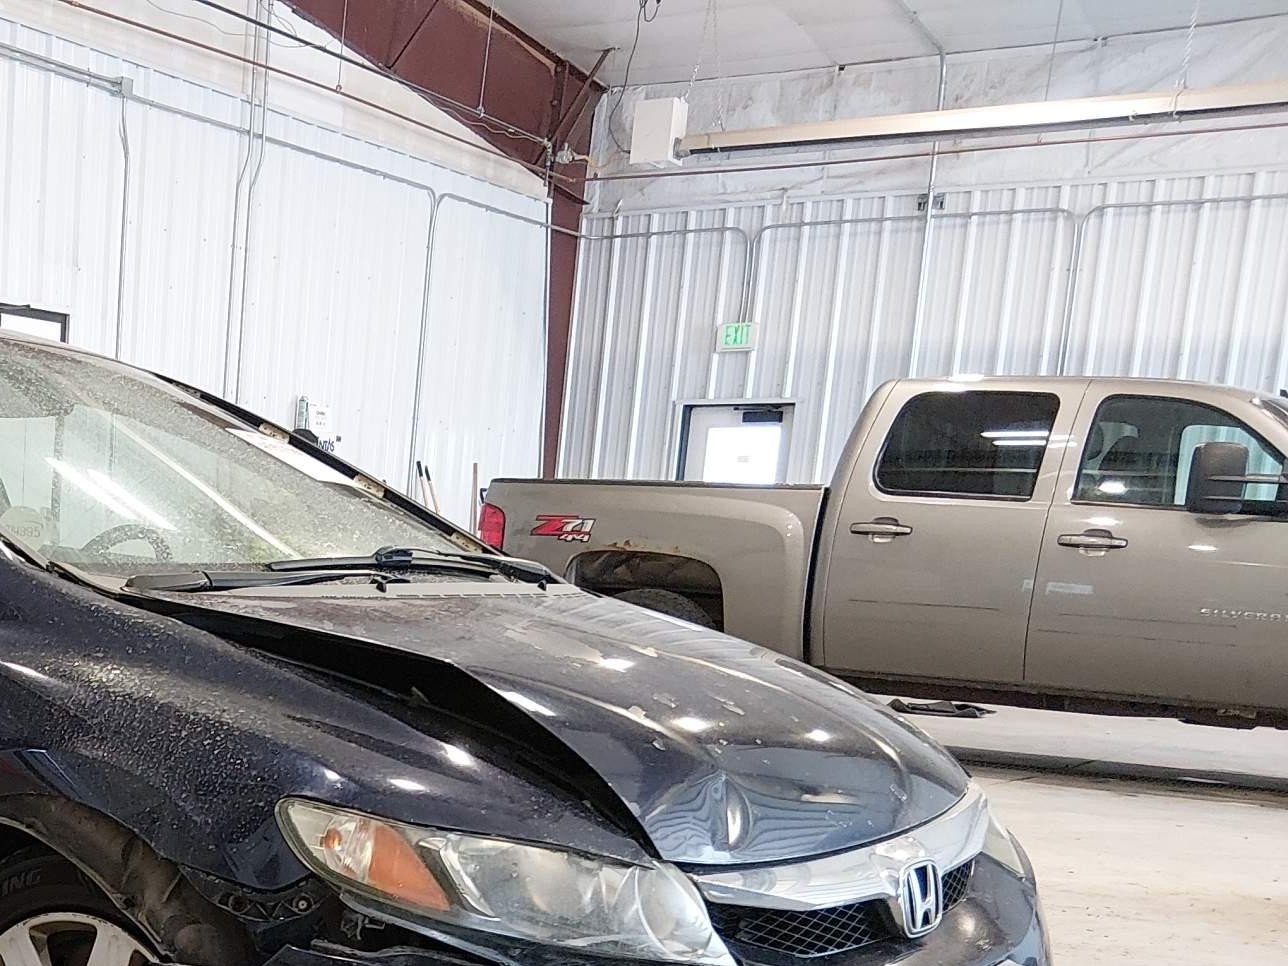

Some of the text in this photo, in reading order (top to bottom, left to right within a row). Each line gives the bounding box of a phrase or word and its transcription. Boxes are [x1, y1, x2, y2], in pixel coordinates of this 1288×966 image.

[725, 324, 751, 345] EXIT
[530, 515, 596, 536] Z71
[1200, 608, 1288, 622] SILVERA
